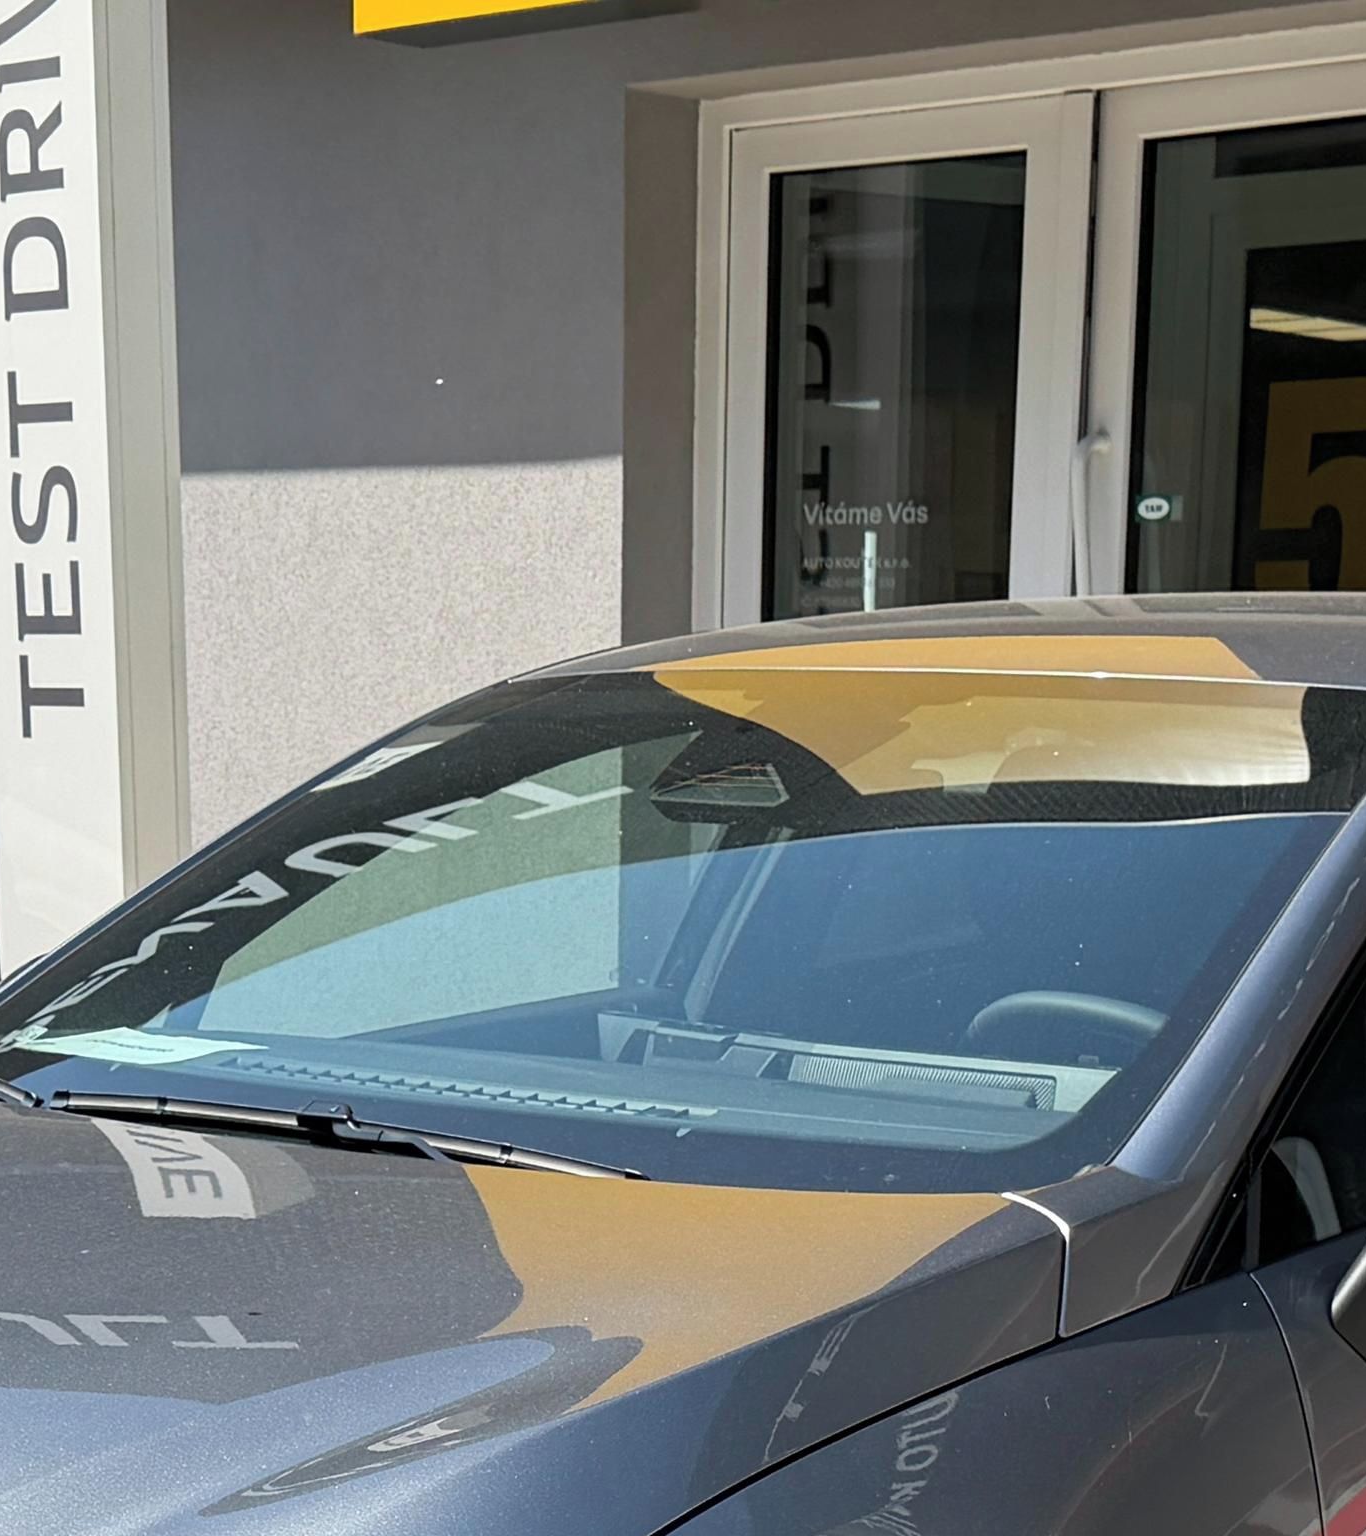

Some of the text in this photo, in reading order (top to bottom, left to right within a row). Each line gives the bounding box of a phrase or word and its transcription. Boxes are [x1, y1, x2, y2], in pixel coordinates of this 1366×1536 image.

[7, 370, 85, 739] TEST
[803, 501, 929, 526] Vítáme Vás
